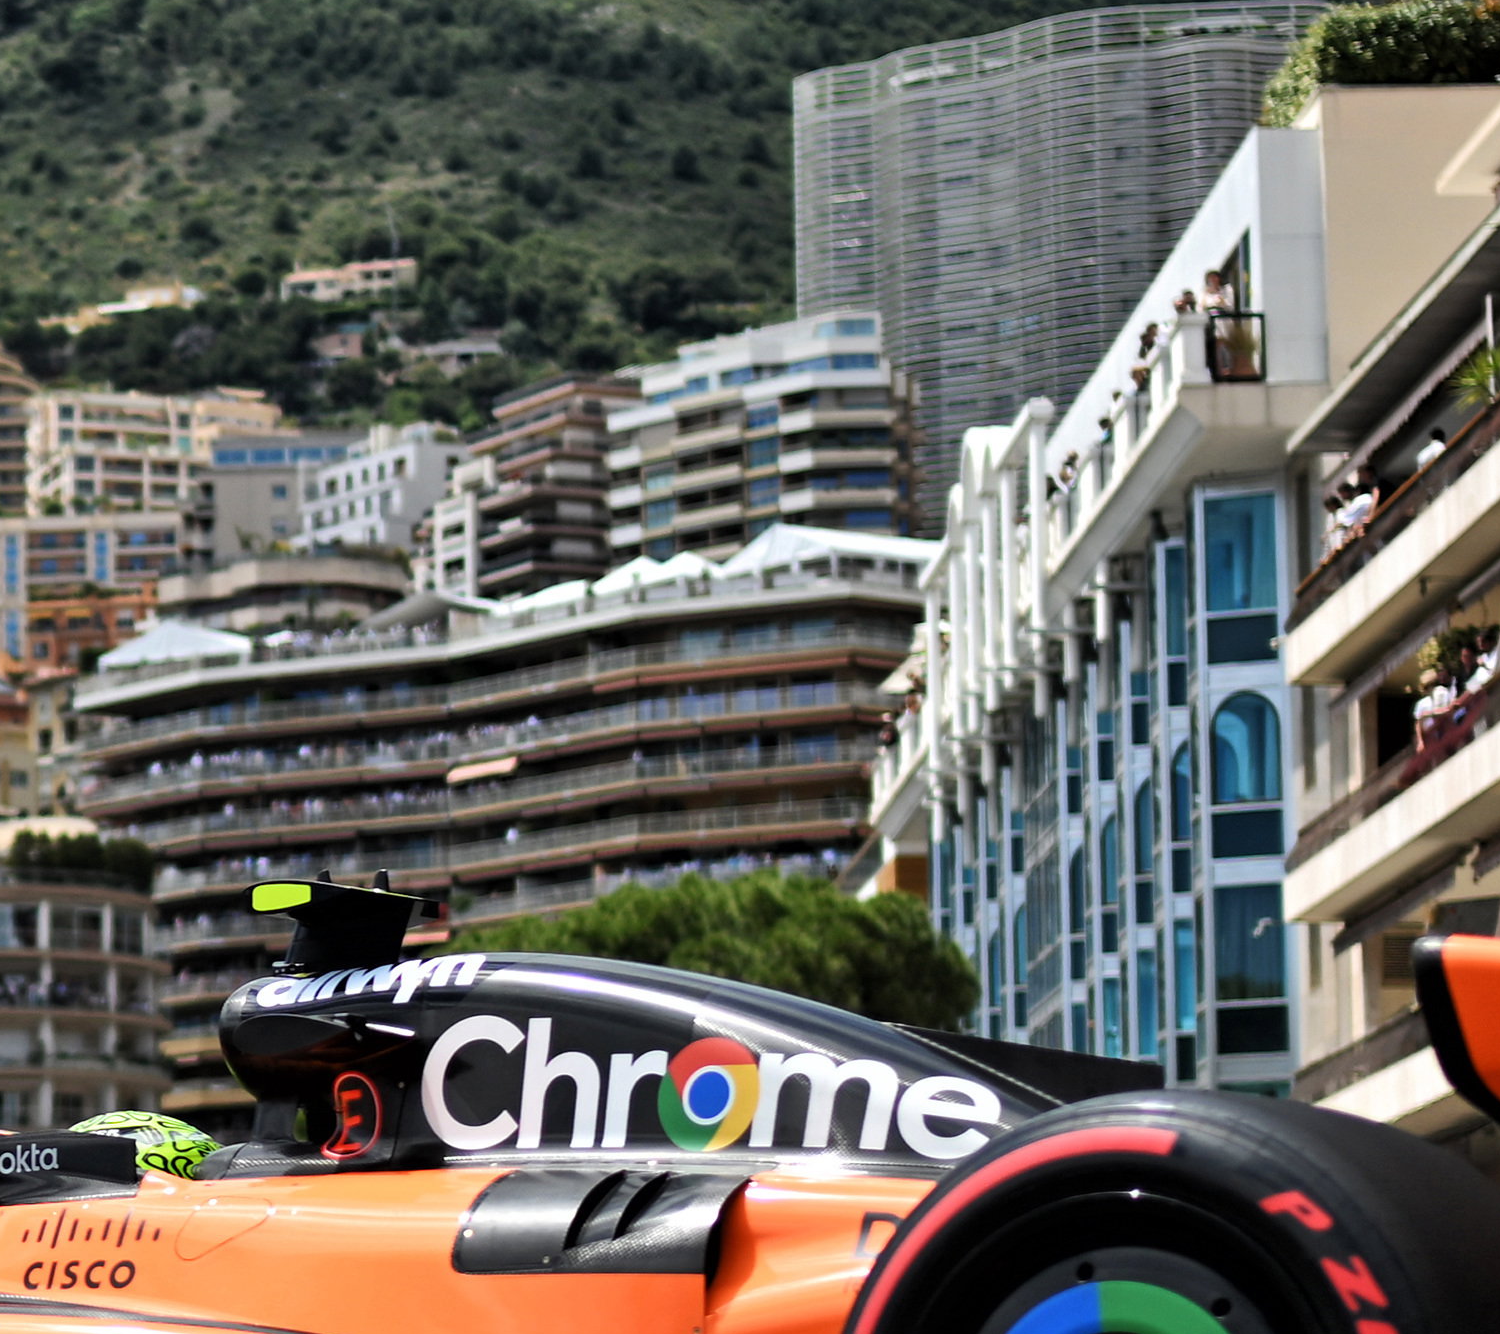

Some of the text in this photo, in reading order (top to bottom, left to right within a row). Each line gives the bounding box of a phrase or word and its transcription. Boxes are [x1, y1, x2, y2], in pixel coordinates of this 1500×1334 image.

[256, 954, 486, 1006] allwyn
[421, 1015, 1001, 1160] Chrome
[1259, 1190, 1334, 1231] P
[23, 1260, 136, 1290] CISCO
